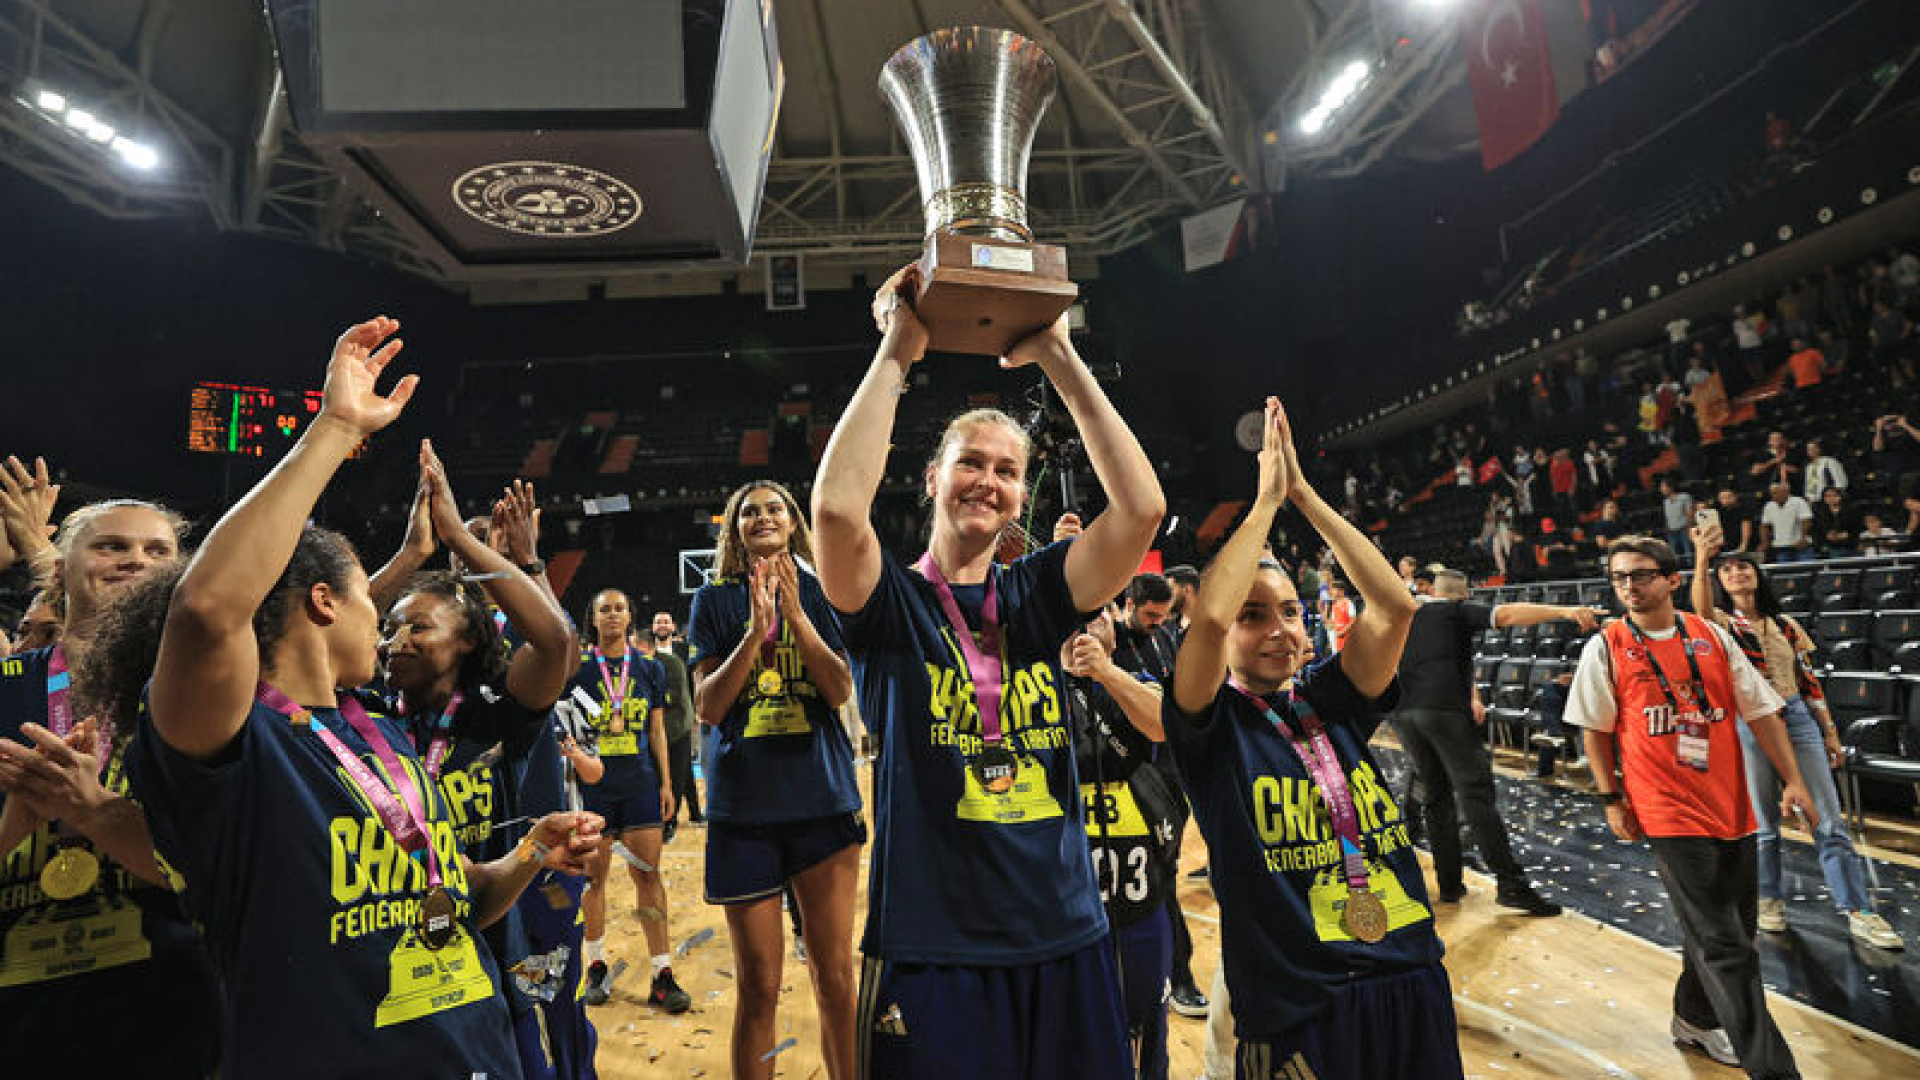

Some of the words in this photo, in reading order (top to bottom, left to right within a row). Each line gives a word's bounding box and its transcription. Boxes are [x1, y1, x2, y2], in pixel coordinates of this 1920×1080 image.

[1252, 760, 1401, 846] CHAPS
[329, 816, 470, 905] CHAPS
[1263, 834, 1367, 873] FENERBA
